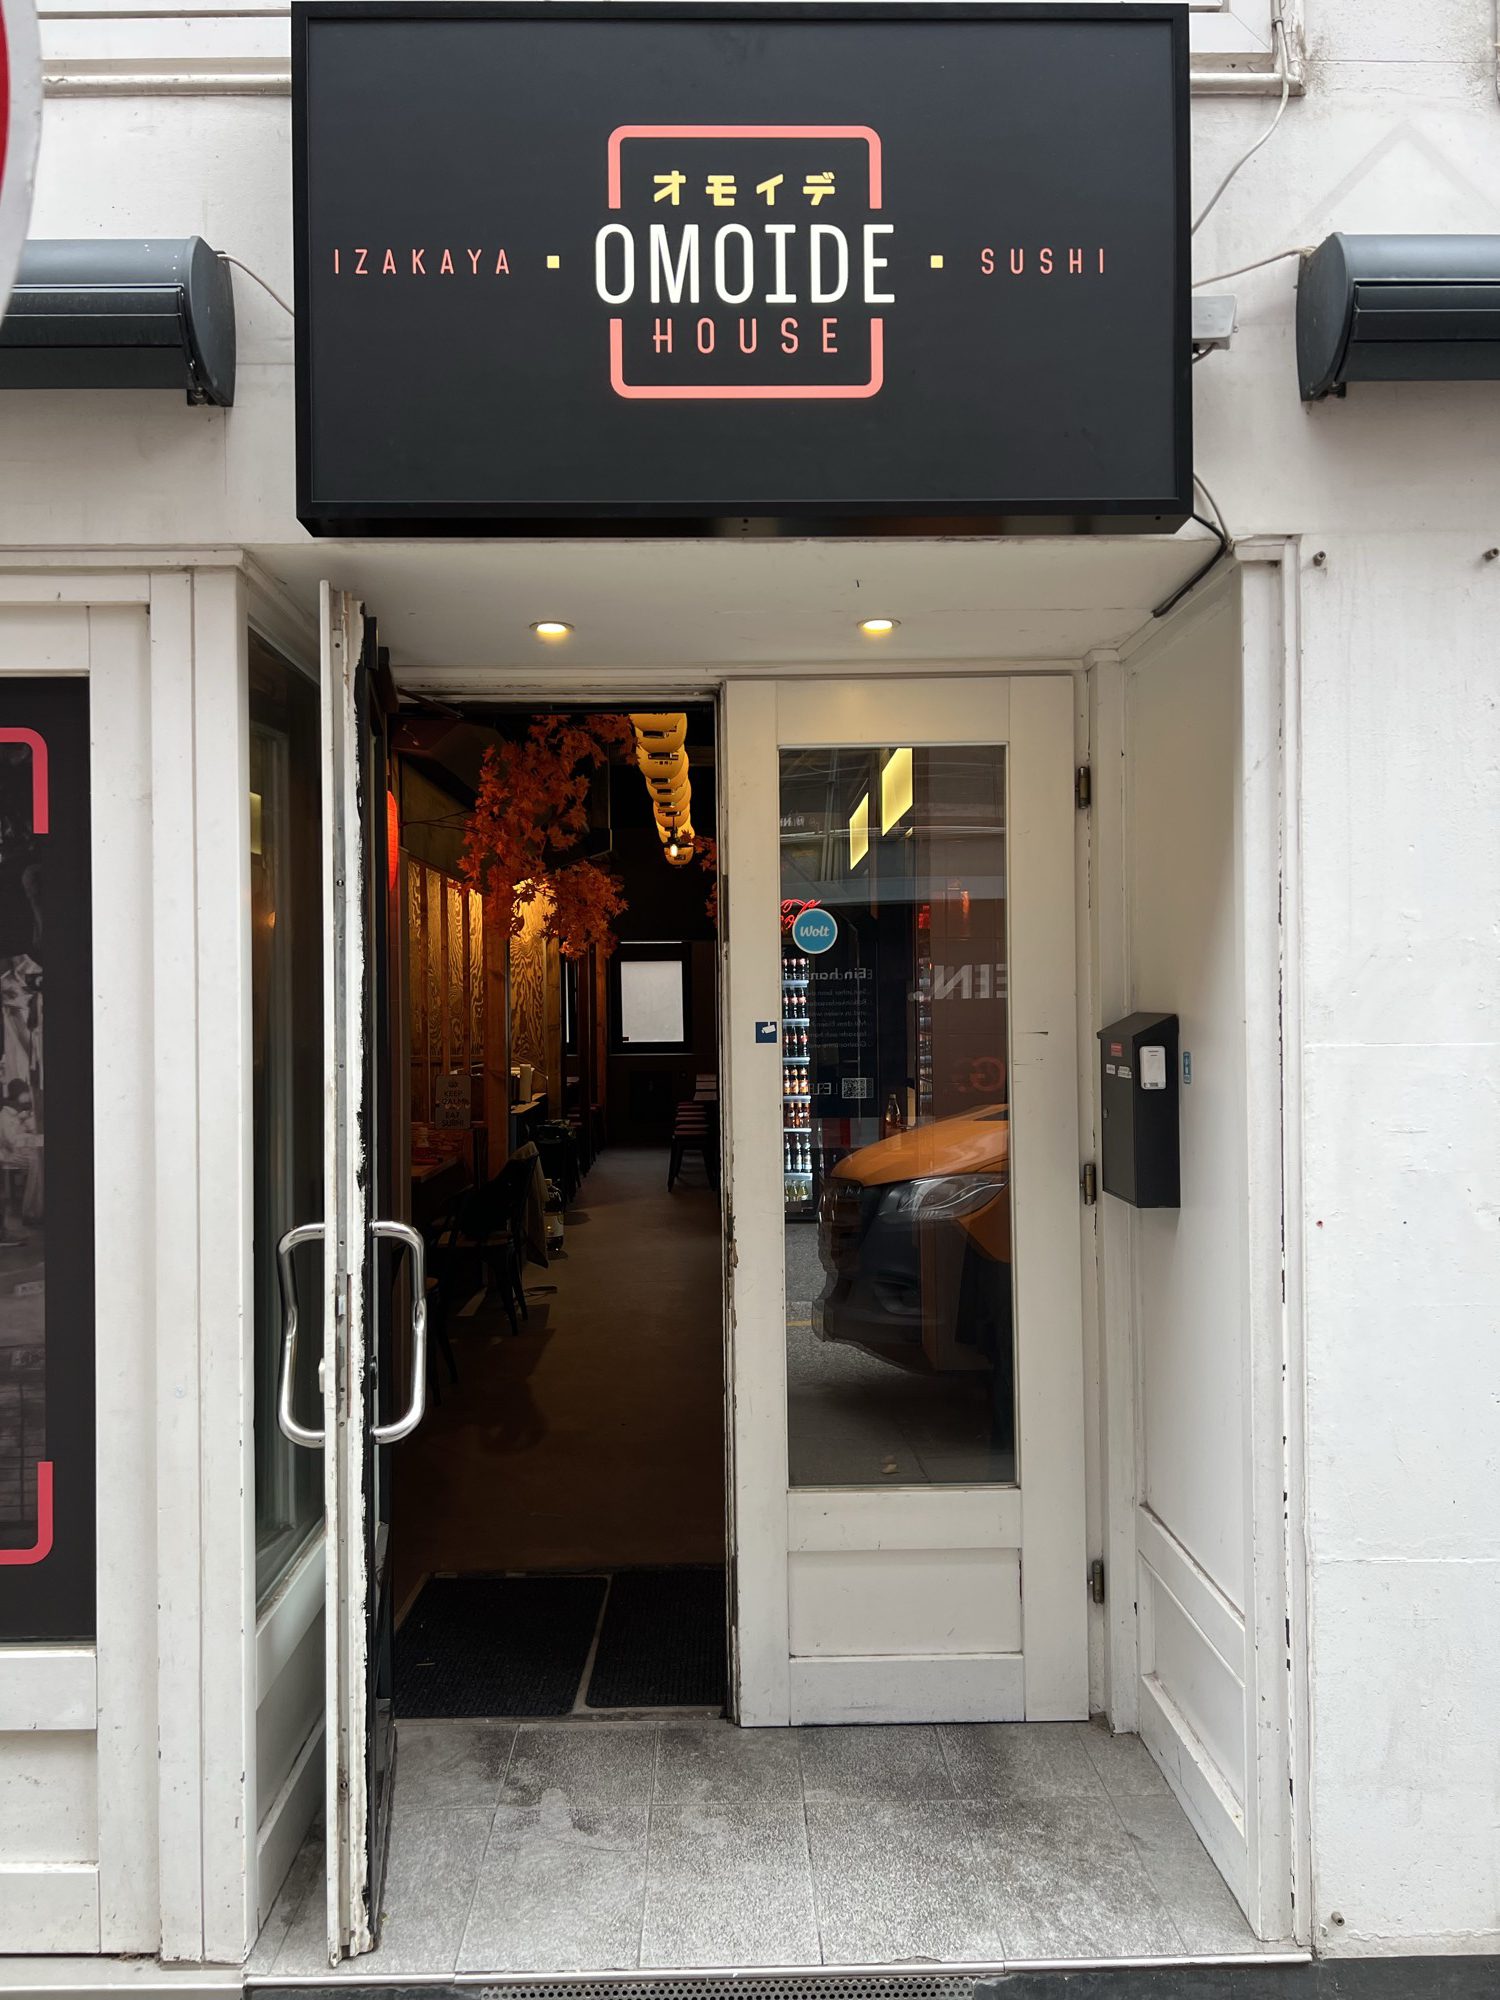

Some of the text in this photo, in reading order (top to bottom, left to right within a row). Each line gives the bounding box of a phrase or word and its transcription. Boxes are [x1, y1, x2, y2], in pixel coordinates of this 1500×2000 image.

[653, 169, 836, 207] オモイデ
[334, 248, 511, 275] IZAKAYA
[594, 223, 896, 305] OMOIDE
[981, 247, 1106, 275] SUSHI
[652, 317, 839, 355] HOUSE
[799, 925, 831, 938] Wolt
